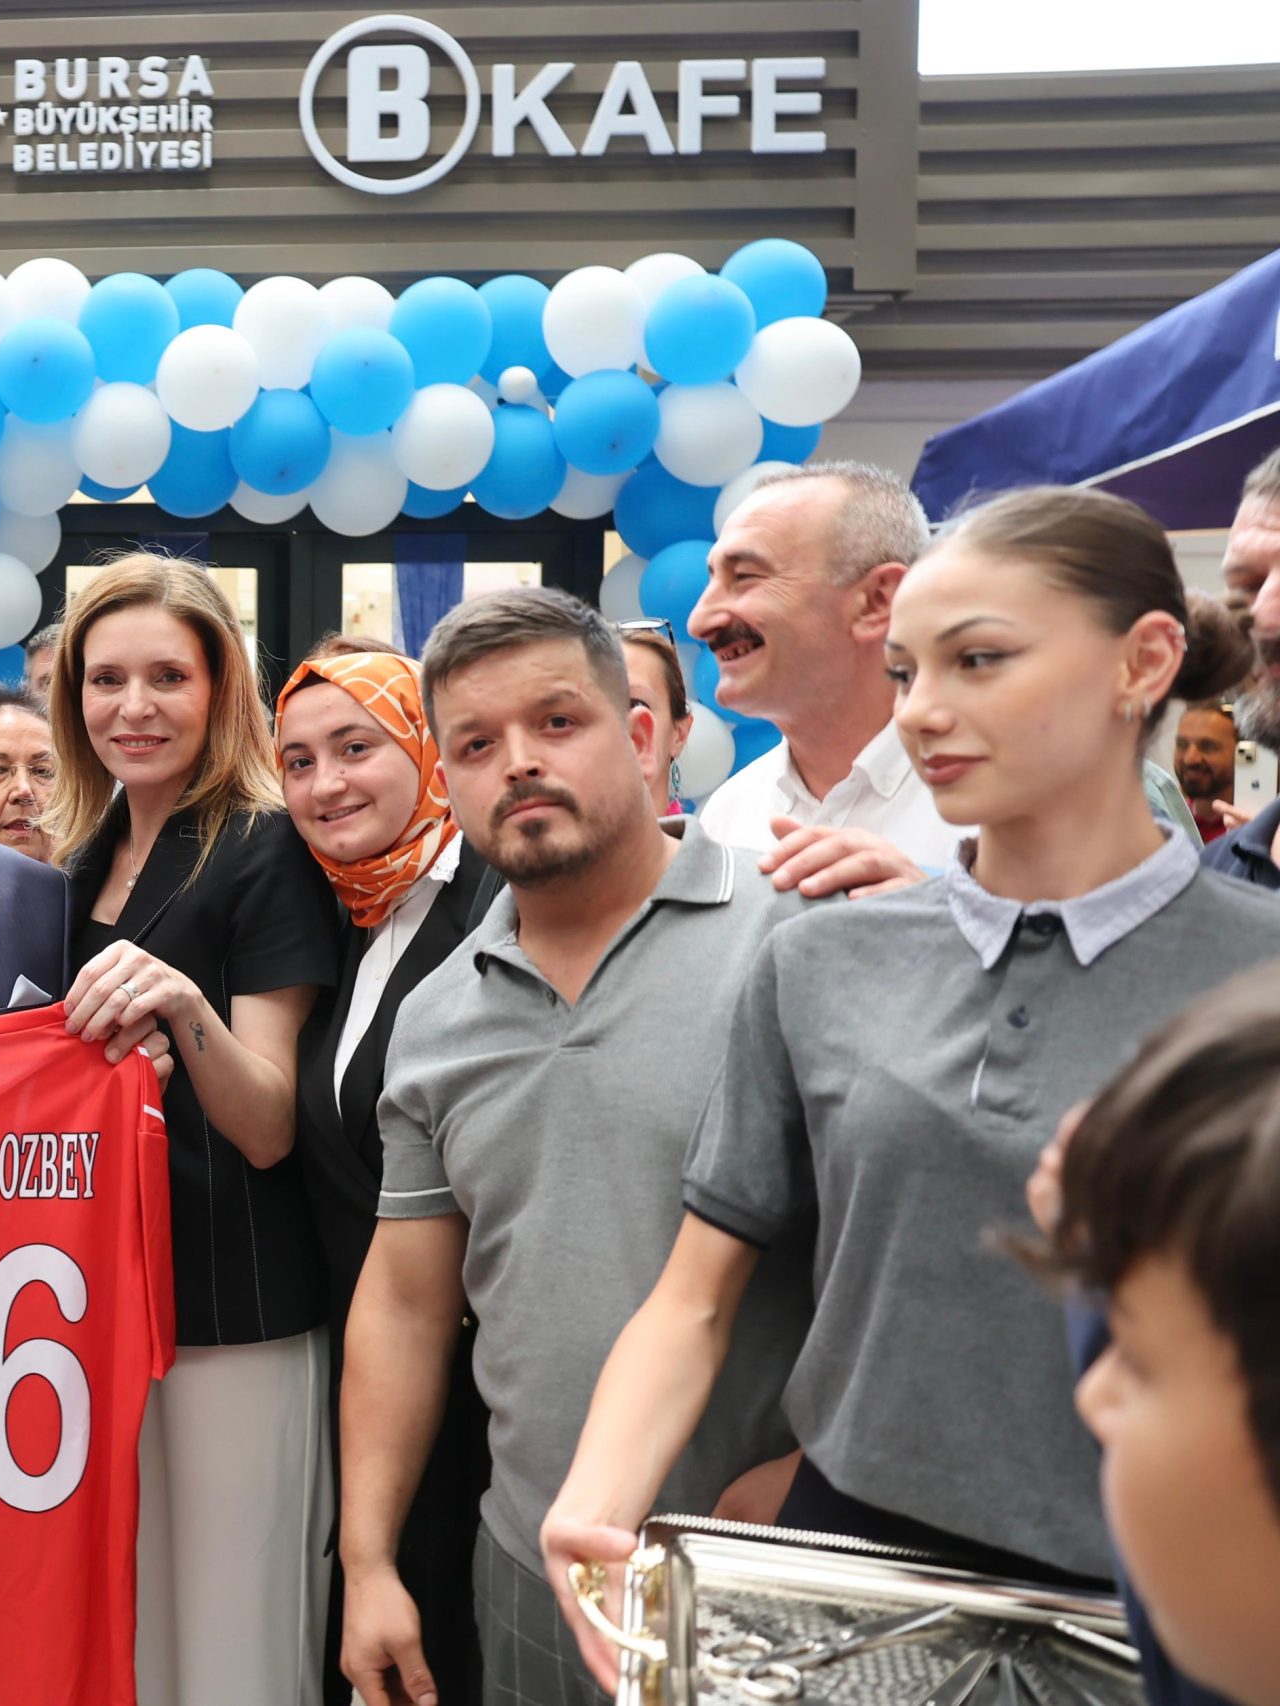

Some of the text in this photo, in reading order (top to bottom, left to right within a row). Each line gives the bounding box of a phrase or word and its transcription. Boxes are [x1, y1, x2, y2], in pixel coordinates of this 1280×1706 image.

[14, 54, 214, 100] BURSA
[13, 98, 214, 136] BÜYÜKŞEHİR
[347, 44, 827, 162] B KAFE
[13, 131, 213, 172] BELEDİYESİ
